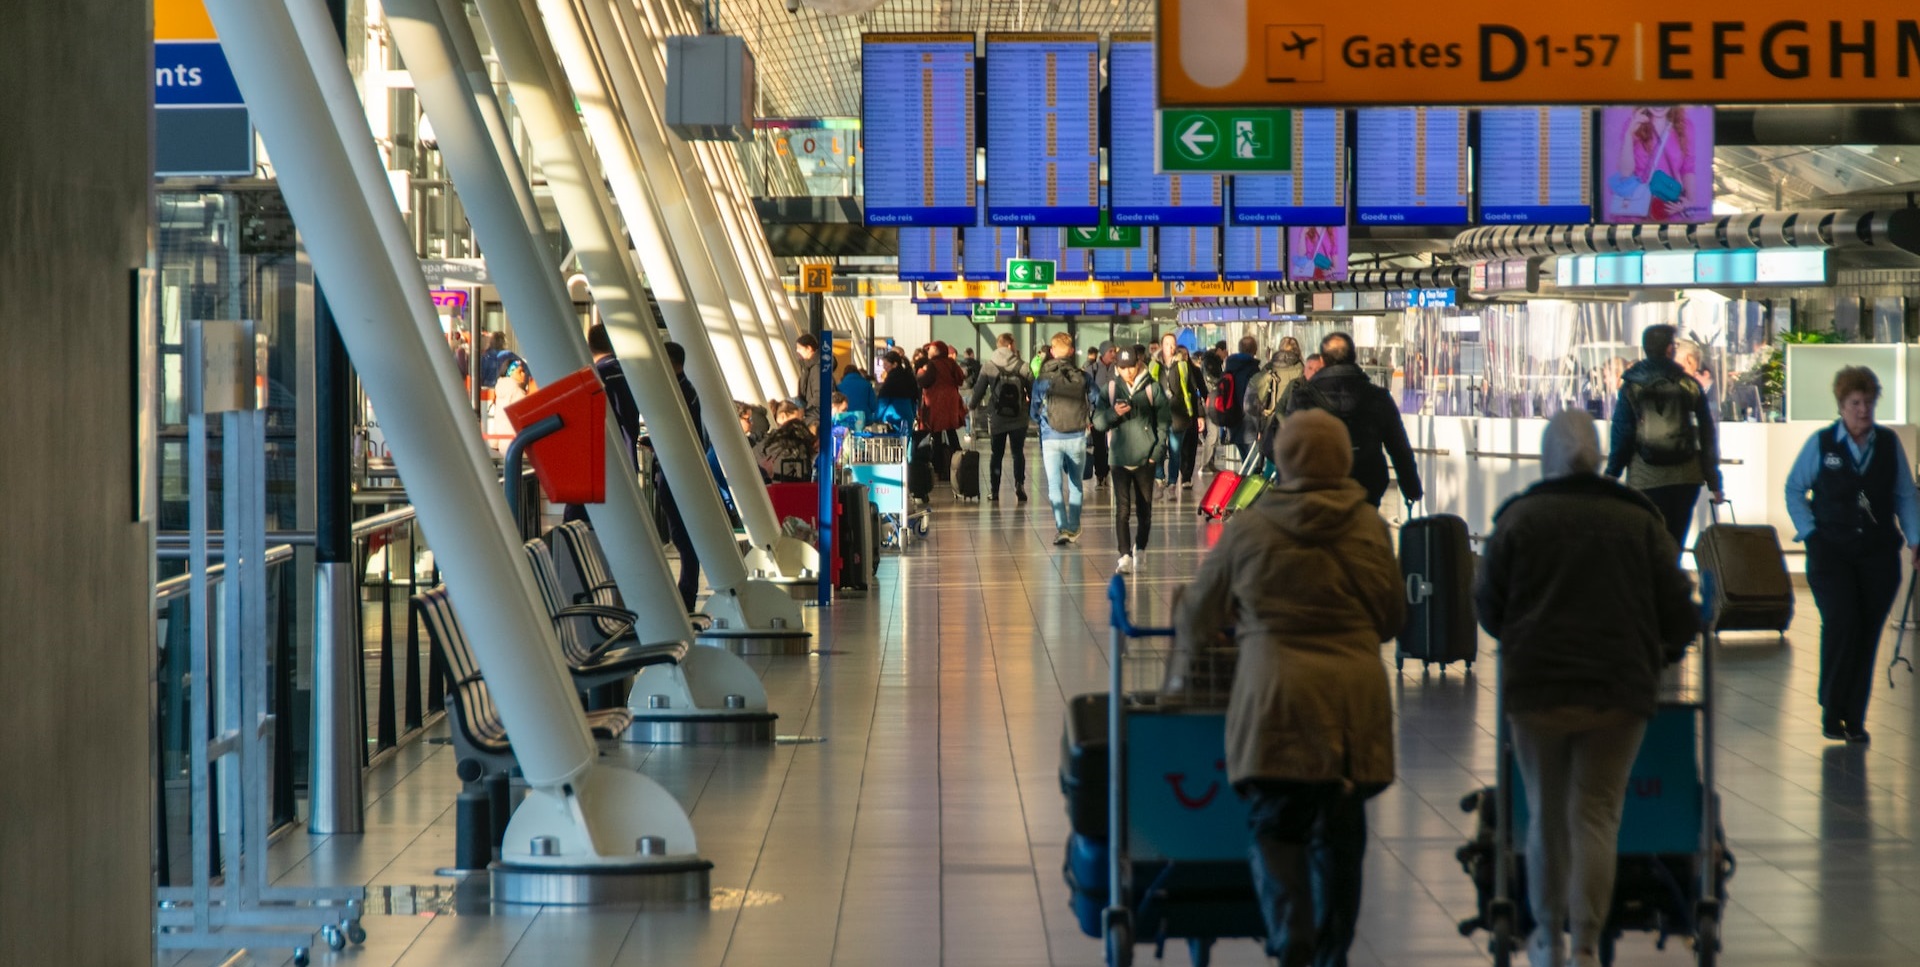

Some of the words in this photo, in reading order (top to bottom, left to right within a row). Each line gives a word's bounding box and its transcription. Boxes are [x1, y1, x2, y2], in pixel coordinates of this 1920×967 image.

[1342, 35, 1462, 69] Gates
[156, 63, 202, 87] nts
[870, 214, 896, 222] Goede
[898, 214, 912, 222] reis
[992, 213, 1017, 222] Goede
[1020, 213, 1036, 222] reis
[1116, 213, 1142, 221] Goede
[1144, 213, 1160, 221] reis
[1238, 213, 1264, 221] Goede
[1266, 213, 1282, 221] reis
[1361, 212, 1387, 220] Goede
[1389, 212, 1404, 220] reis
[1484, 212, 1510, 220] Goede
[1512, 212, 1528, 220] reis
[1200, 281, 1220, 289] Gates
